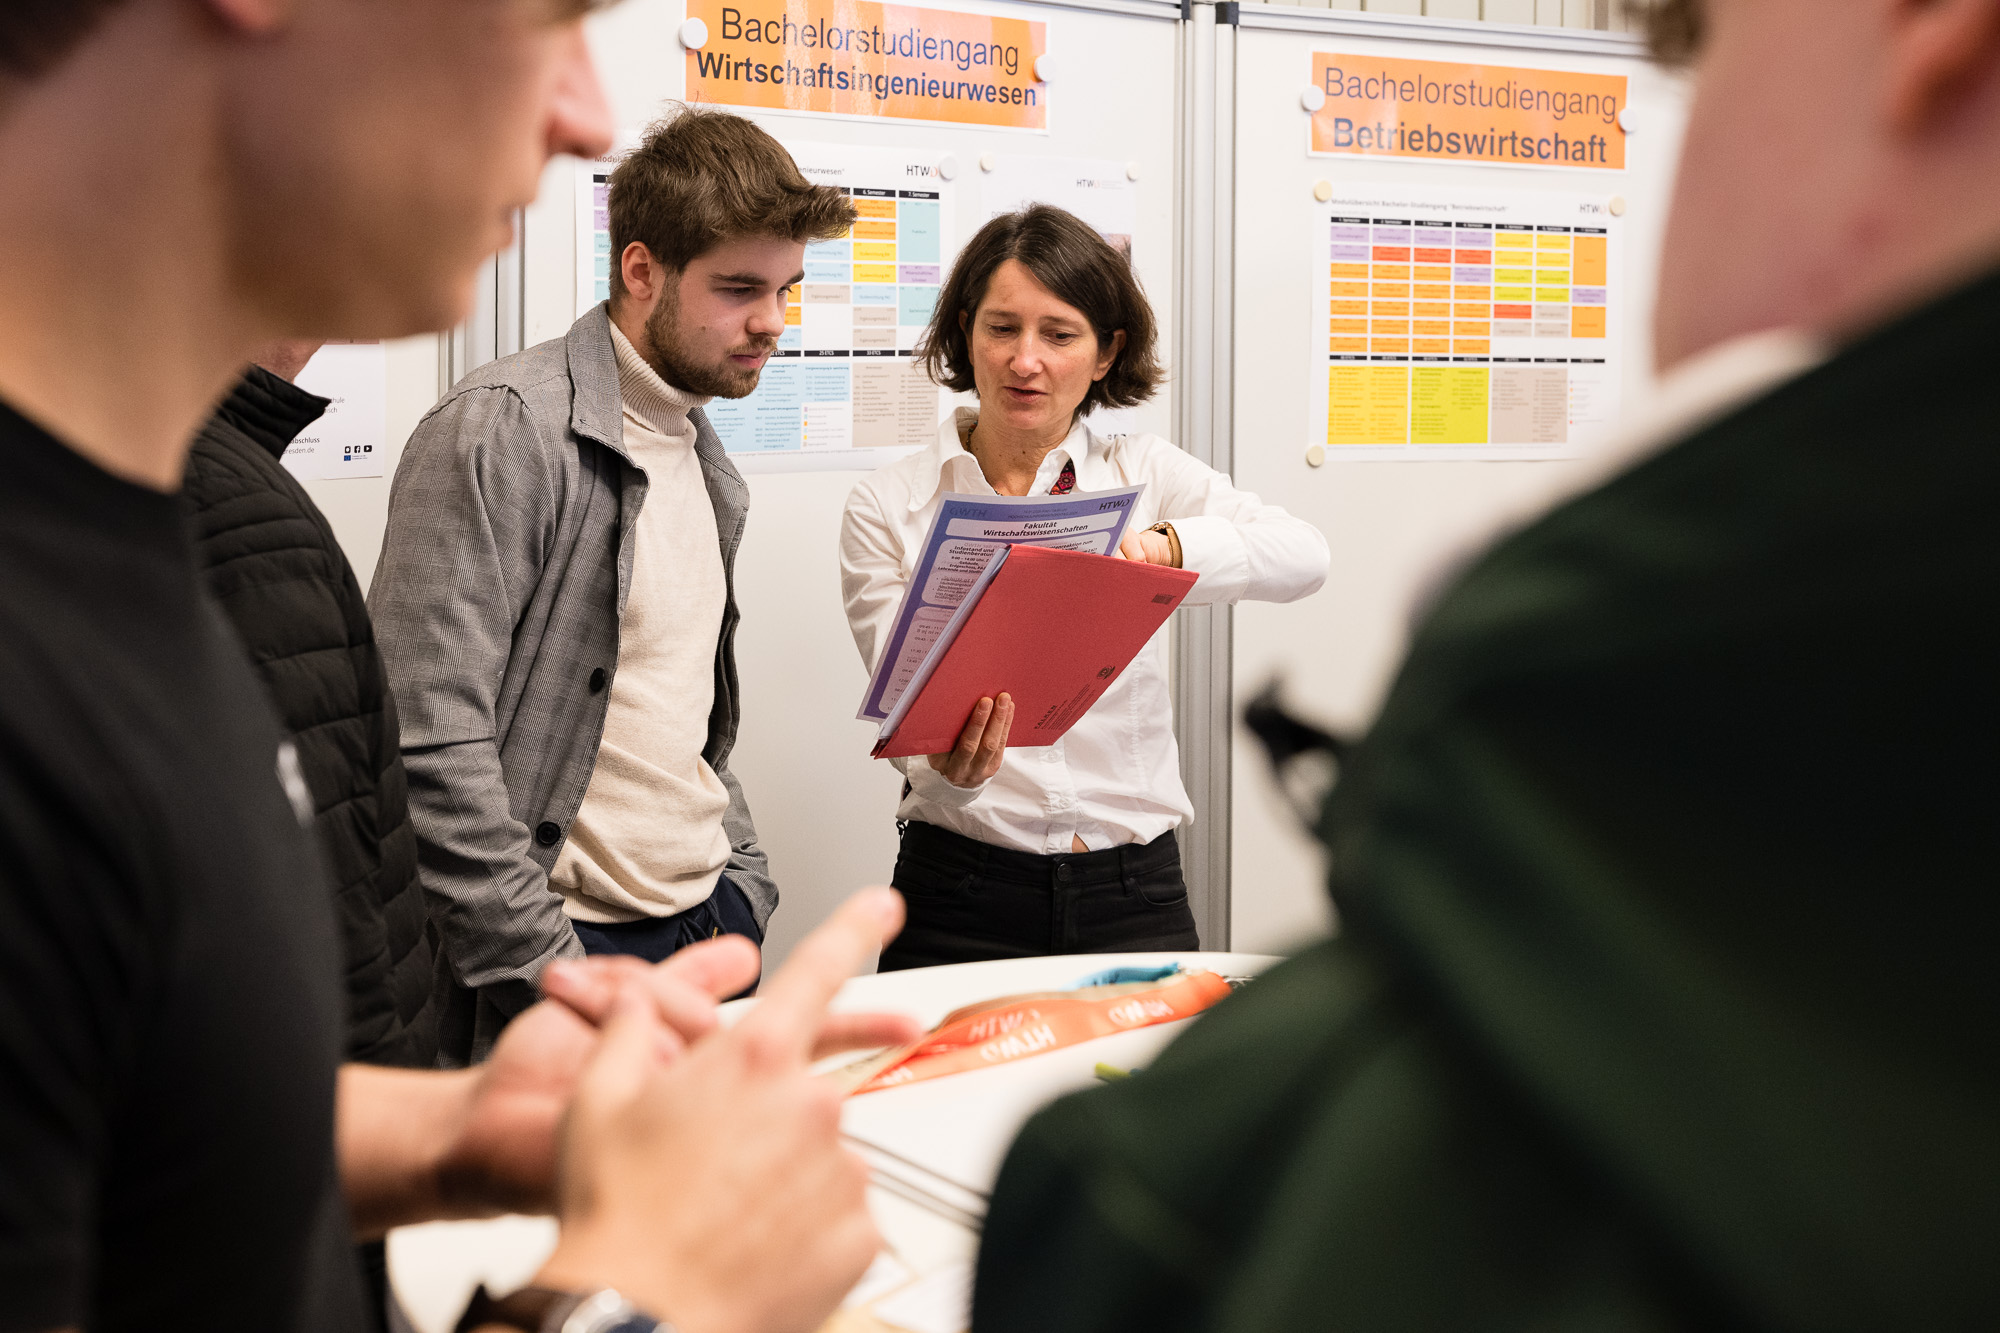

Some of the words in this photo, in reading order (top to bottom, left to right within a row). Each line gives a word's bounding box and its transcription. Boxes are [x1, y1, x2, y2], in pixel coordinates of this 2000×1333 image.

[722, 6, 1019, 76] Bachelorstudiengang
[697, 50, 1036, 106] Wirtschaftsingenieurwesen
[1325, 67, 1617, 124] Bachelorstudiengang
[1333, 117, 1608, 163] Betriebswirtschaft
[983, 525, 1088, 537] Wirtschaftswissenschaften
[1023, 521, 1057, 530] Fakultät
